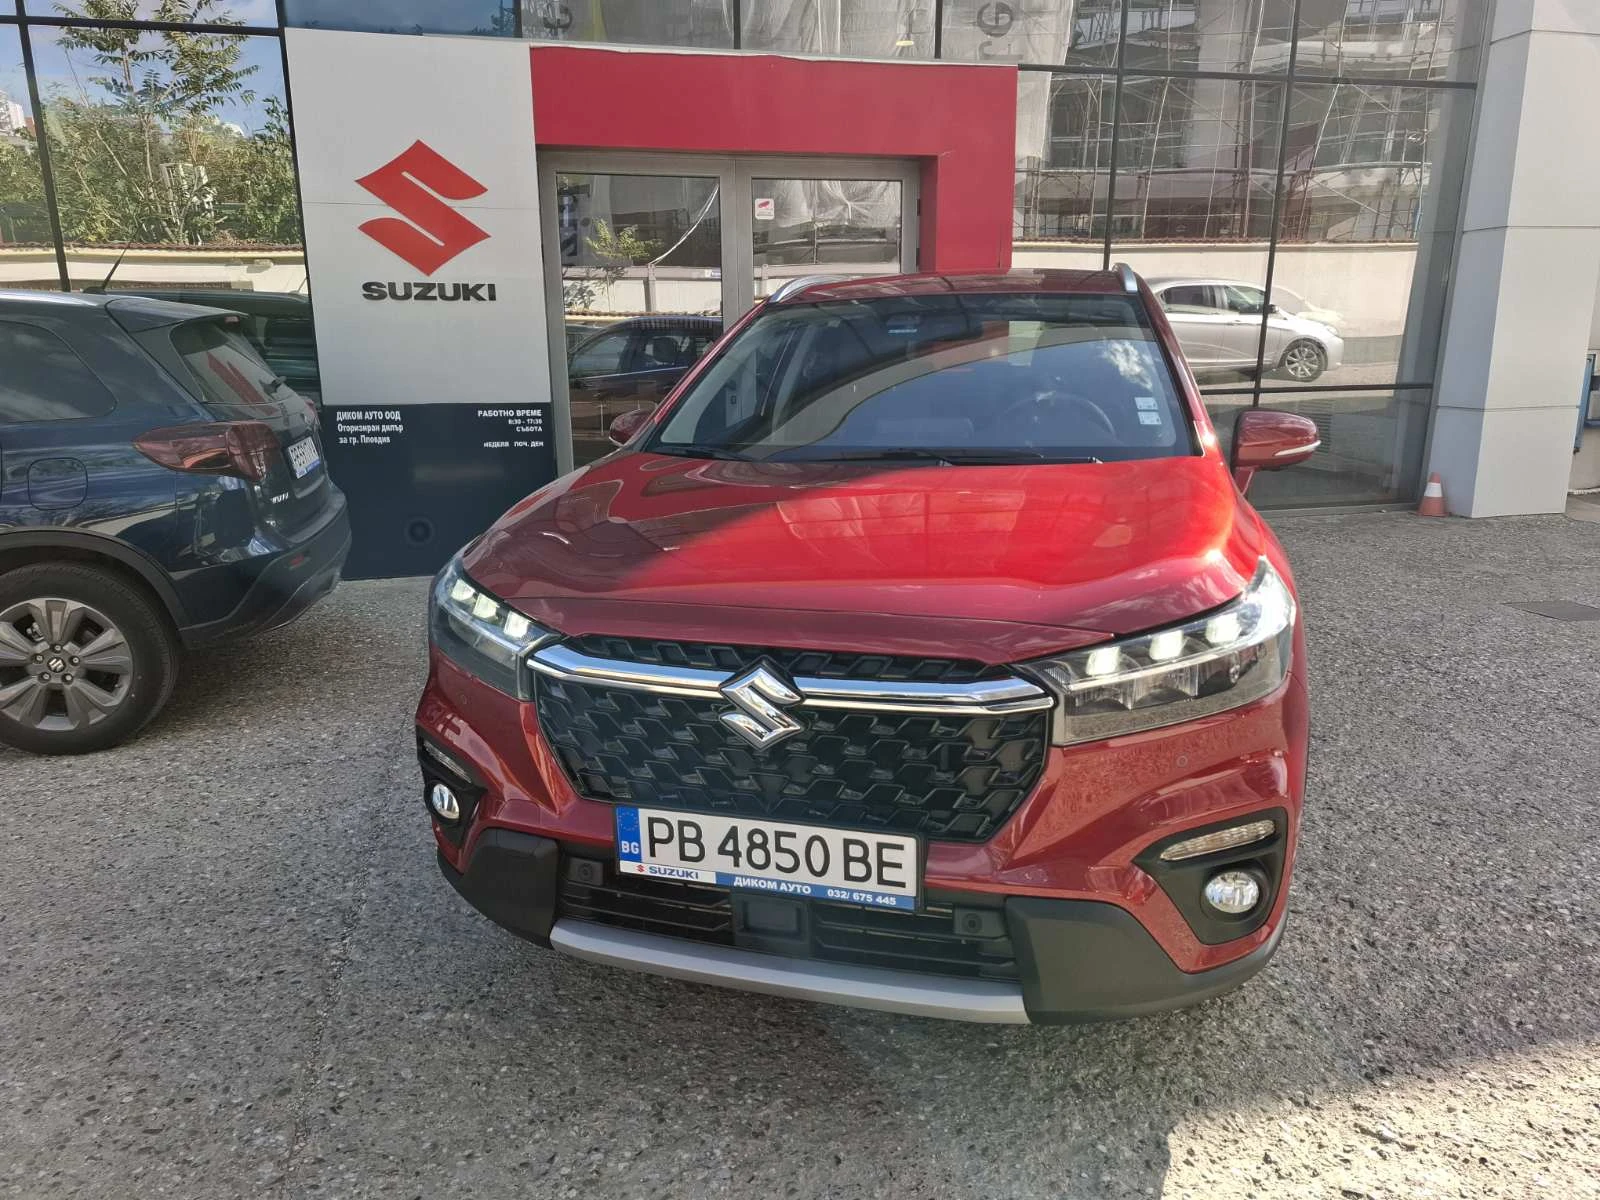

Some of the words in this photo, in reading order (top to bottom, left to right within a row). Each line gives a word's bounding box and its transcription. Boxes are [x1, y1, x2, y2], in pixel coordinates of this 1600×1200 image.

[362, 281, 497, 301] SUZUKI
[336, 411, 363, 421] ДИКОМ
[365, 411, 383, 420] АУТО
[385, 411, 401, 421] ООД
[337, 423, 380, 433] Оторизиран
[360, 435, 391, 444] Пловдив
[621, 840, 640, 855] BG
[647, 816, 706, 863] PB
[717, 825, 831, 878] 4850
[843, 838, 907, 888] BE
[648, 866, 699, 880] SUZUKI
[733, 876, 778, 890] ДИКОМ
[779, 883, 812, 895] АУТО
[827, 889, 850, 899] 032/
[852, 892, 873, 903] 675
[875, 895, 897, 906] 445
